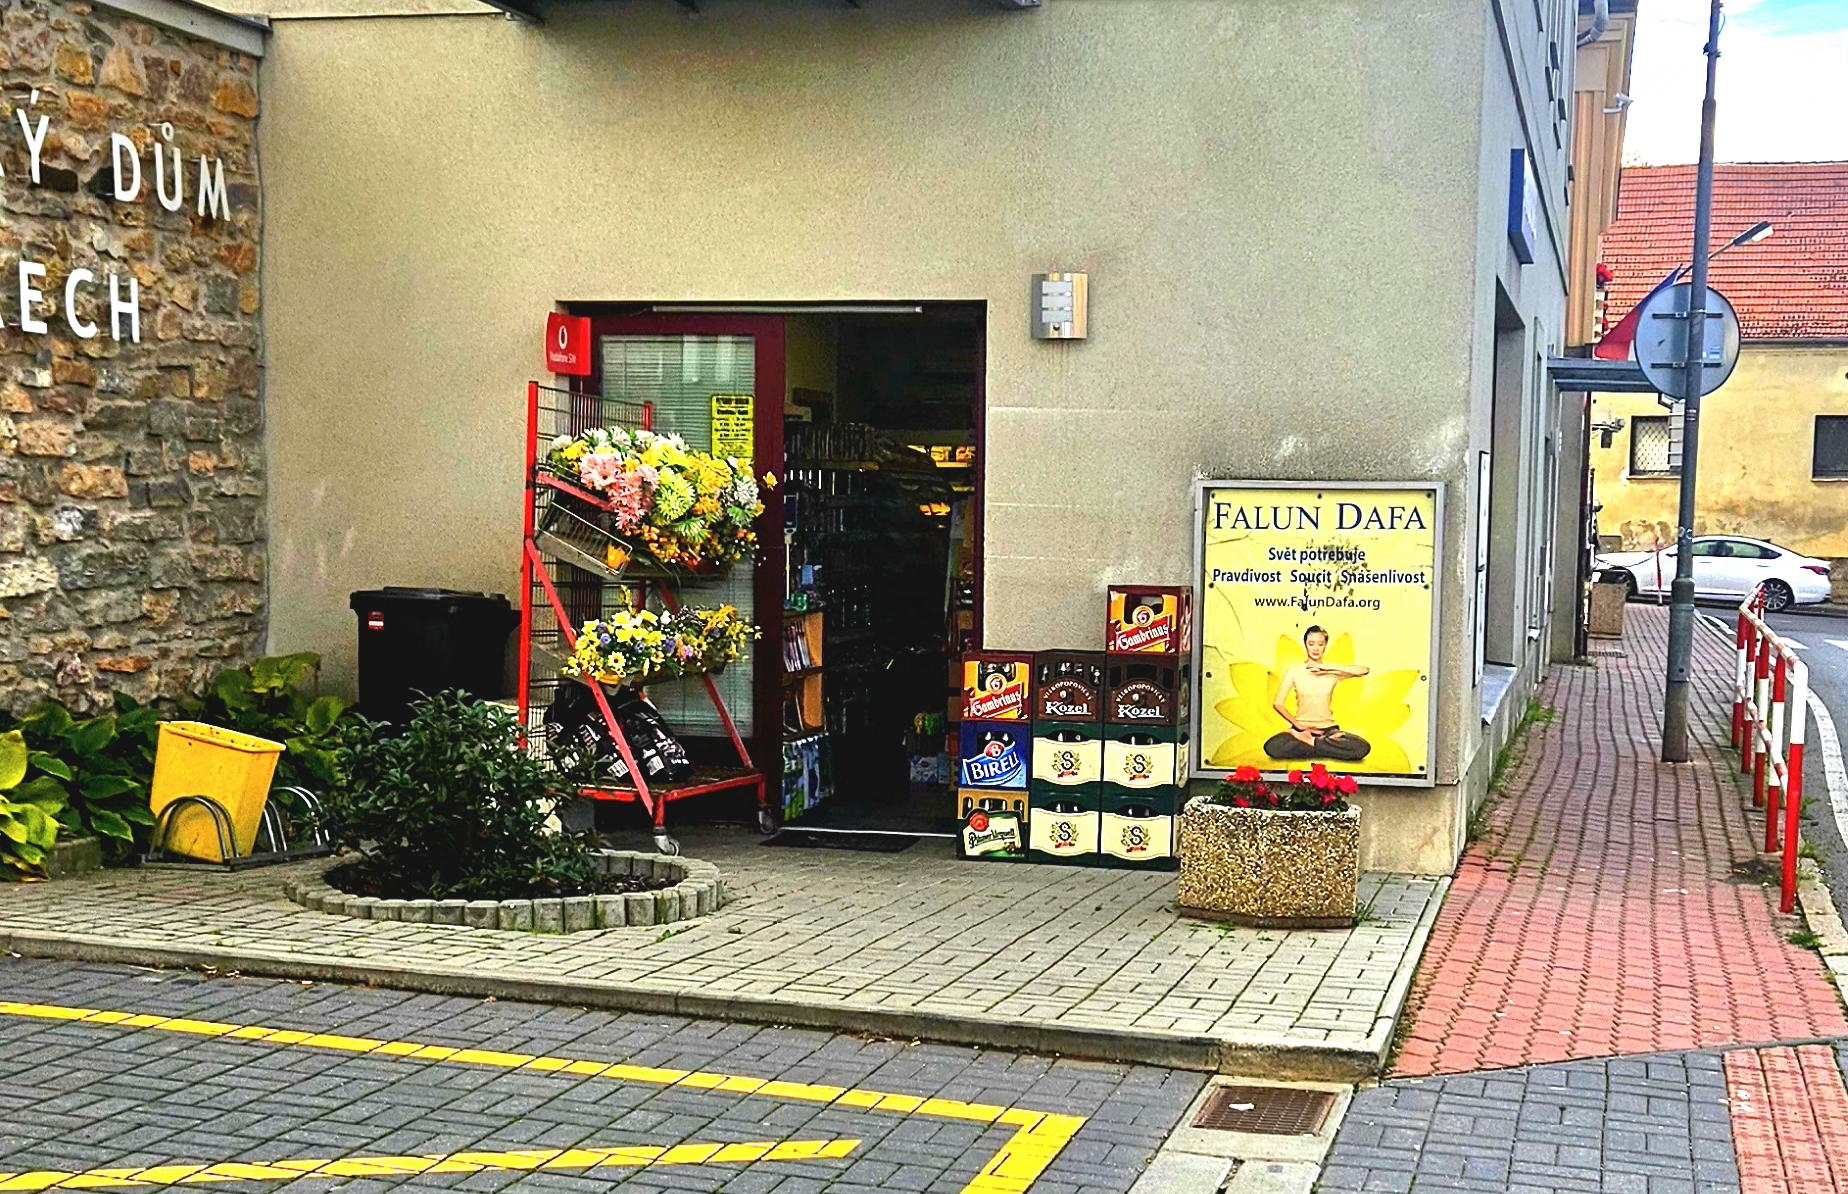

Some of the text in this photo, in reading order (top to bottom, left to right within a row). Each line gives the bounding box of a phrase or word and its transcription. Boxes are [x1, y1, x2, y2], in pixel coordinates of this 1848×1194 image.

[0, 90, 230, 221] Ý DŮM
[0, 261, 140, 343] ECH
[1213, 502, 1427, 530] FALUN DAFA
[1268, 546, 1366, 564] Svět potřebuje
[1213, 568, 1282, 583] Pravdivost
[1341, 566, 1426, 583] Snášenlivost
[1254, 597, 1381, 611] www.FalunDafa.org
[1118, 624, 1169, 650] Gambrinus
[972, 690, 1021, 716] Gambrinus
[1045, 701, 1092, 716] Kozel
[1117, 704, 1165, 719] Kozel
[970, 751, 1020, 780] BIRELL
